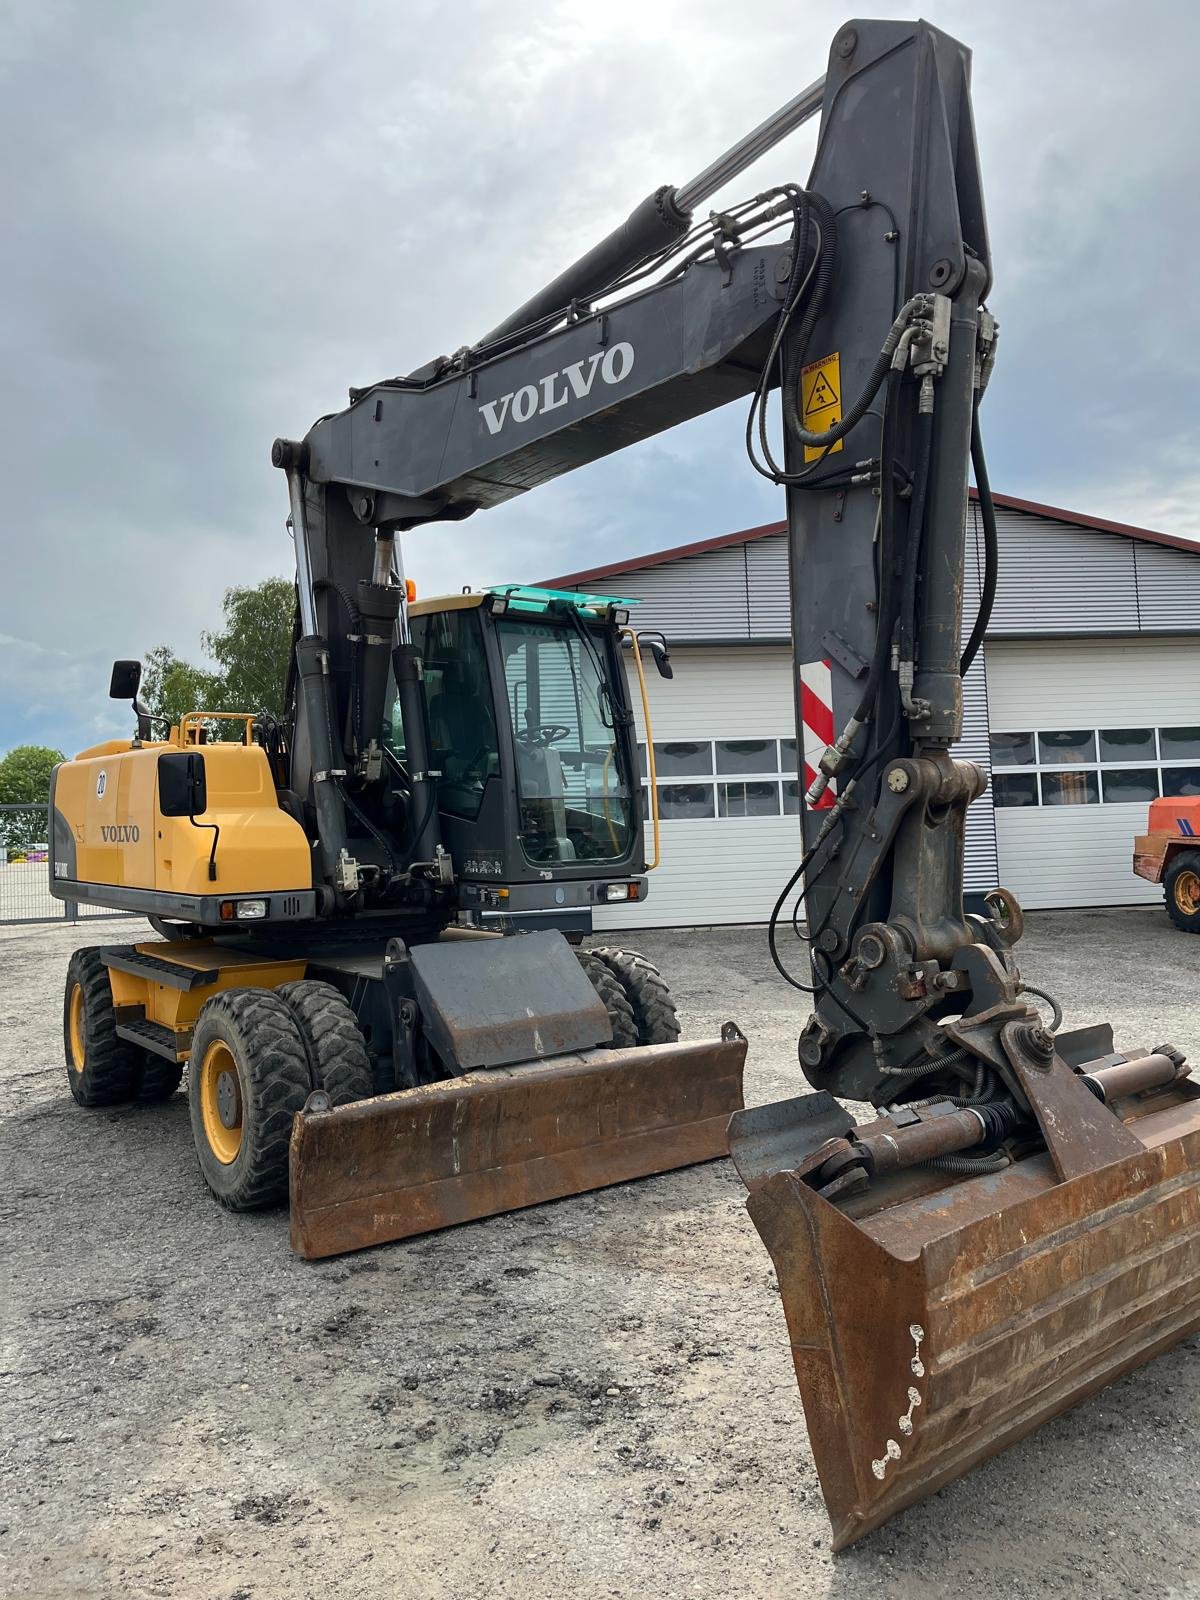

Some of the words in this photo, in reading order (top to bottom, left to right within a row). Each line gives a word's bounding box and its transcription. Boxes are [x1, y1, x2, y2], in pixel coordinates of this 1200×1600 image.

[478, 341, 635, 435] VOLVO
[98, 774, 105, 794] 20
[100, 825, 140, 843] VOLVO
